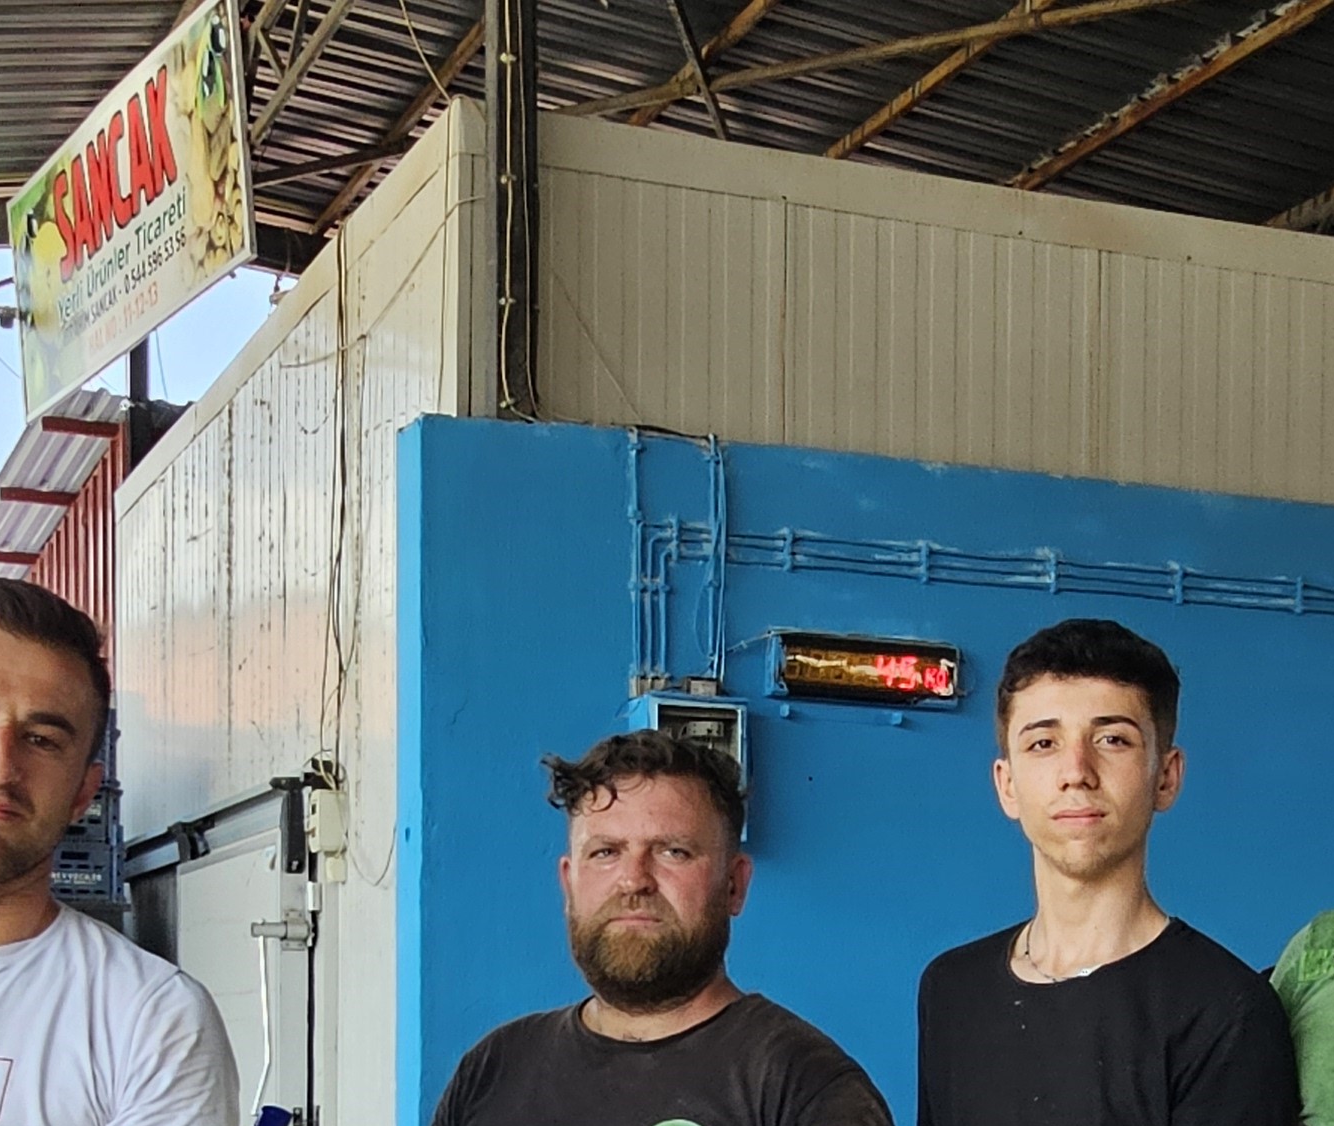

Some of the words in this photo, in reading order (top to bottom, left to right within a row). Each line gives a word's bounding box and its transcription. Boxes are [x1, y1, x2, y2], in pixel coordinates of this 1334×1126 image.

[53, 64, 177, 283] SANCAK
[87, 242, 131, 298] Ürünler
[135, 187, 186, 255] Ticareti
